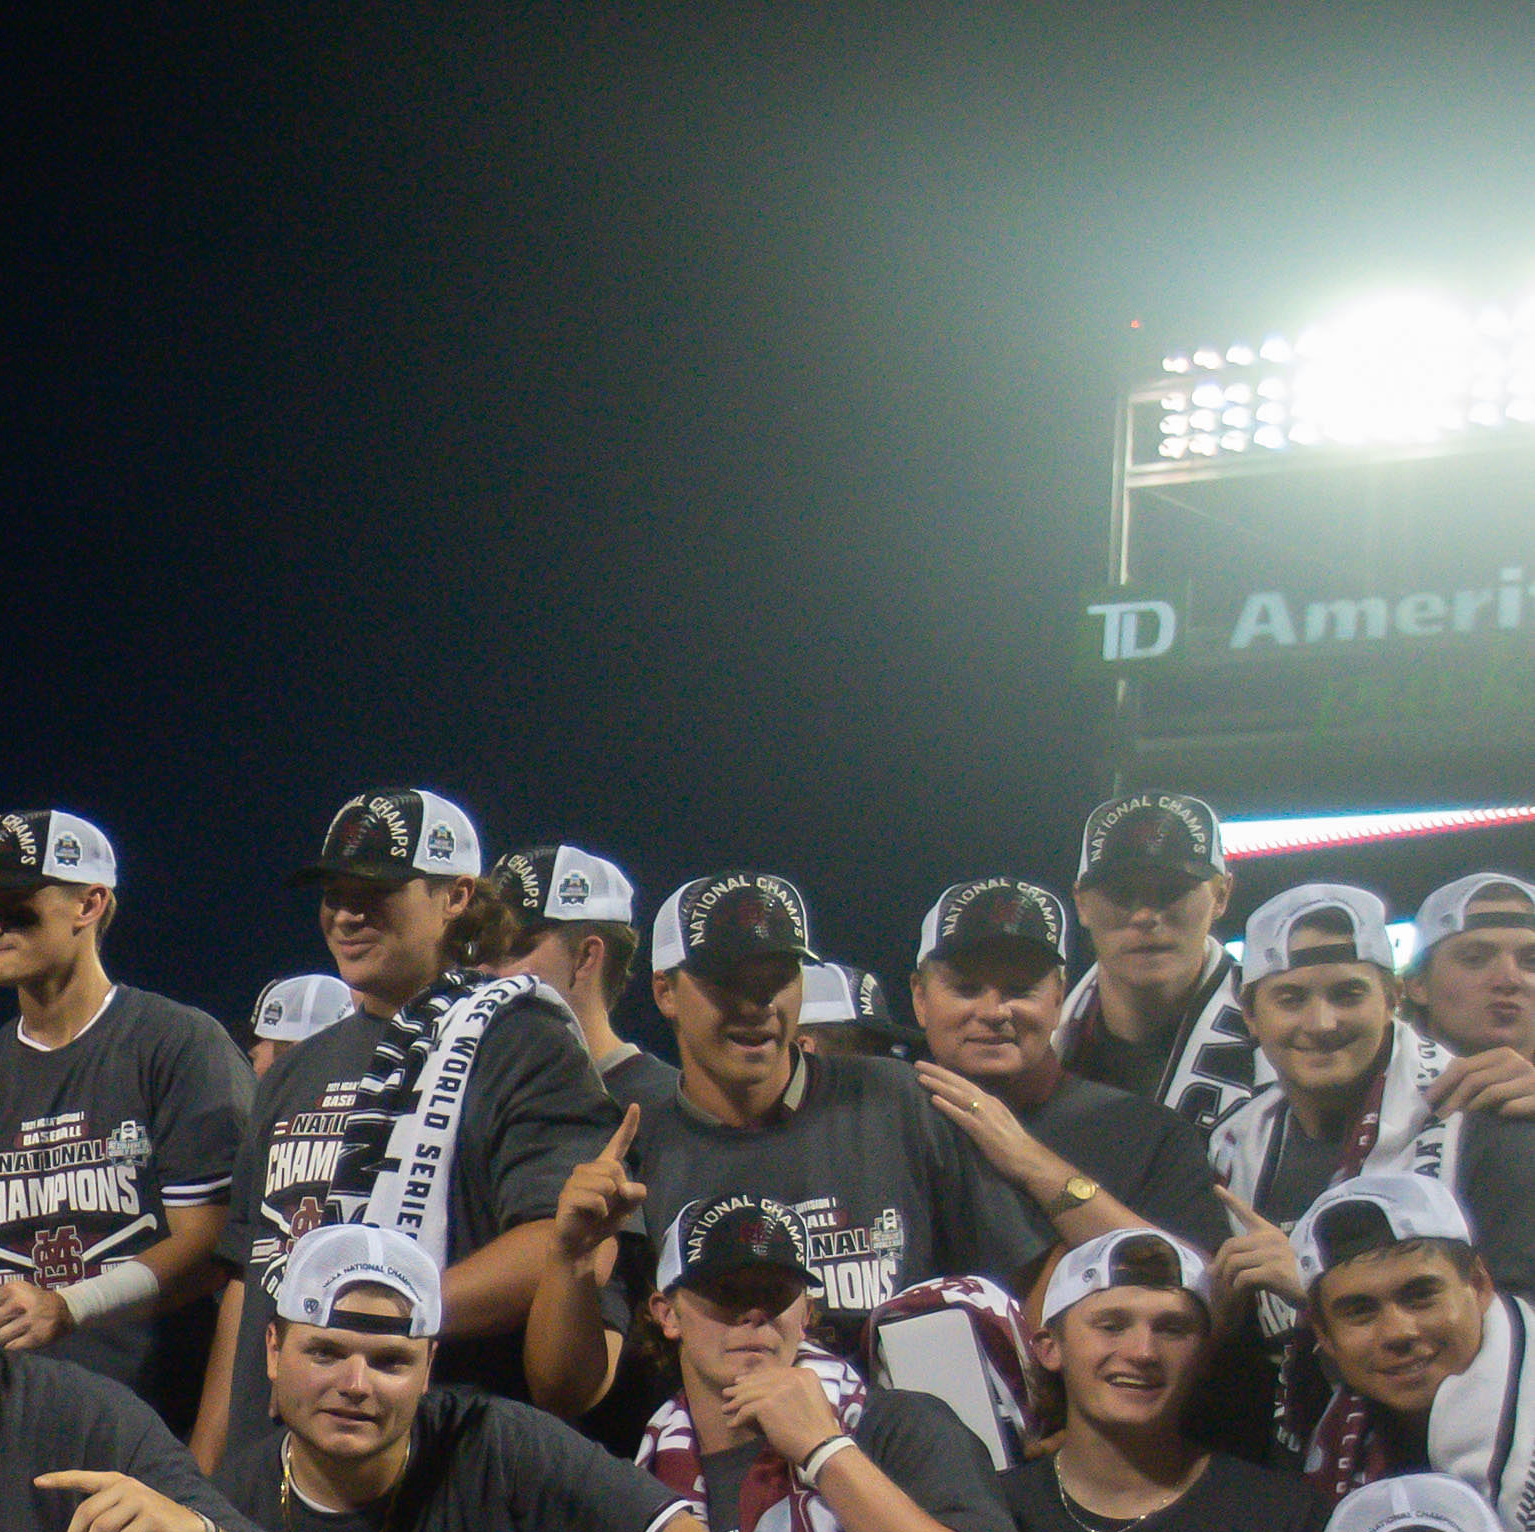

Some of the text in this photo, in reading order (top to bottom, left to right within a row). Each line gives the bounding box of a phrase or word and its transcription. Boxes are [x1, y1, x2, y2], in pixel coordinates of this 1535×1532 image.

[1086, 567, 1535, 661] TD Ameri
[2, 813, 37, 866] CHAMPS
[369, 796, 408, 858] CHAMPS
[1089, 795, 1208, 864] NATIONAL CHAMPS
[507, 854, 539, 908] CHAMPS
[689, 873, 806, 947] NATIONAL CHAMPS
[942, 878, 1057, 945] NATIONAL CHAMPS
[424, 1036, 478, 1130] WORLD
[23, 1125, 83, 1146] BASEBALL
[687, 1195, 755, 1263] NATIONAL
[761, 1198, 804, 1264] CHAMPS
[344, 1263, 384, 1273] NATIONAL
